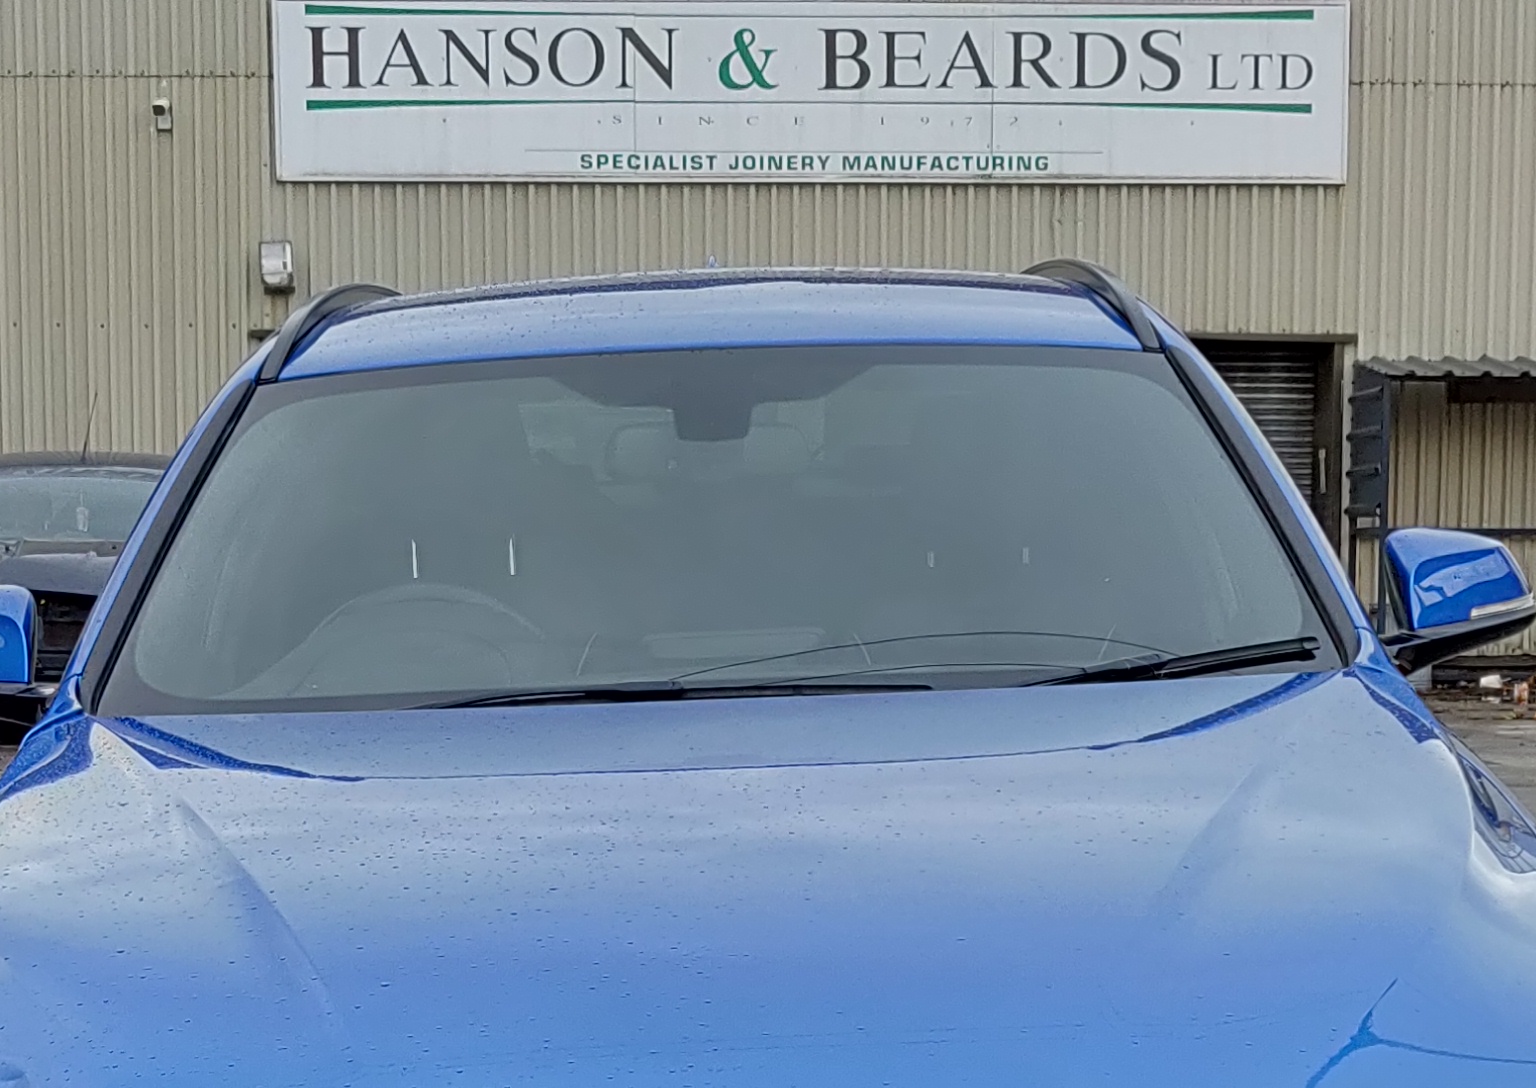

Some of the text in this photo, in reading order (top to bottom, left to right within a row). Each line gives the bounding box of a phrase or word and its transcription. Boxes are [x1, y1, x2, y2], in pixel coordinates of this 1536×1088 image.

[305, 26, 1314, 92] HANSON & BEARDS LTD
[580, 153, 1049, 172] SPECIALIST JOINERY MANUFACTURING
